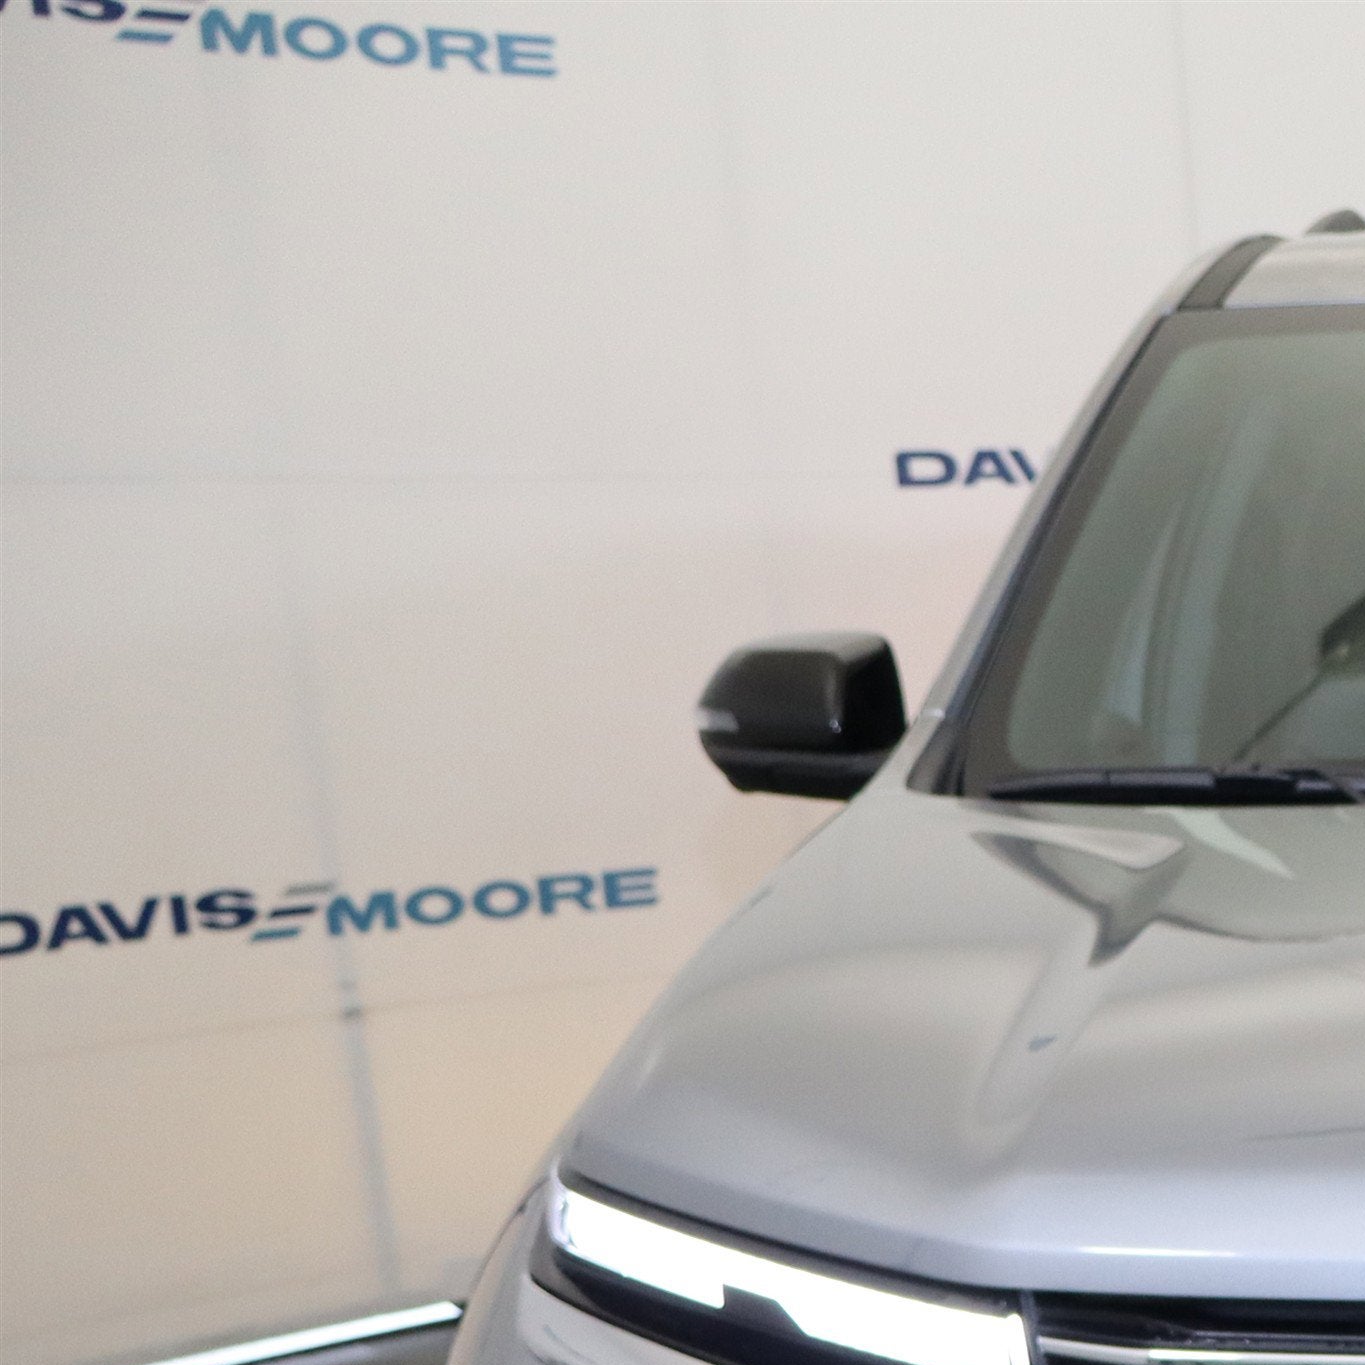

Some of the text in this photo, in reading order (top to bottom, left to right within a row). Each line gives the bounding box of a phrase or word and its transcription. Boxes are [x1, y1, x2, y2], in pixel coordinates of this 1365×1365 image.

[198, 8, 556, 77] MOORE
[0, 868, 657, 957] DAVIS MOORE
